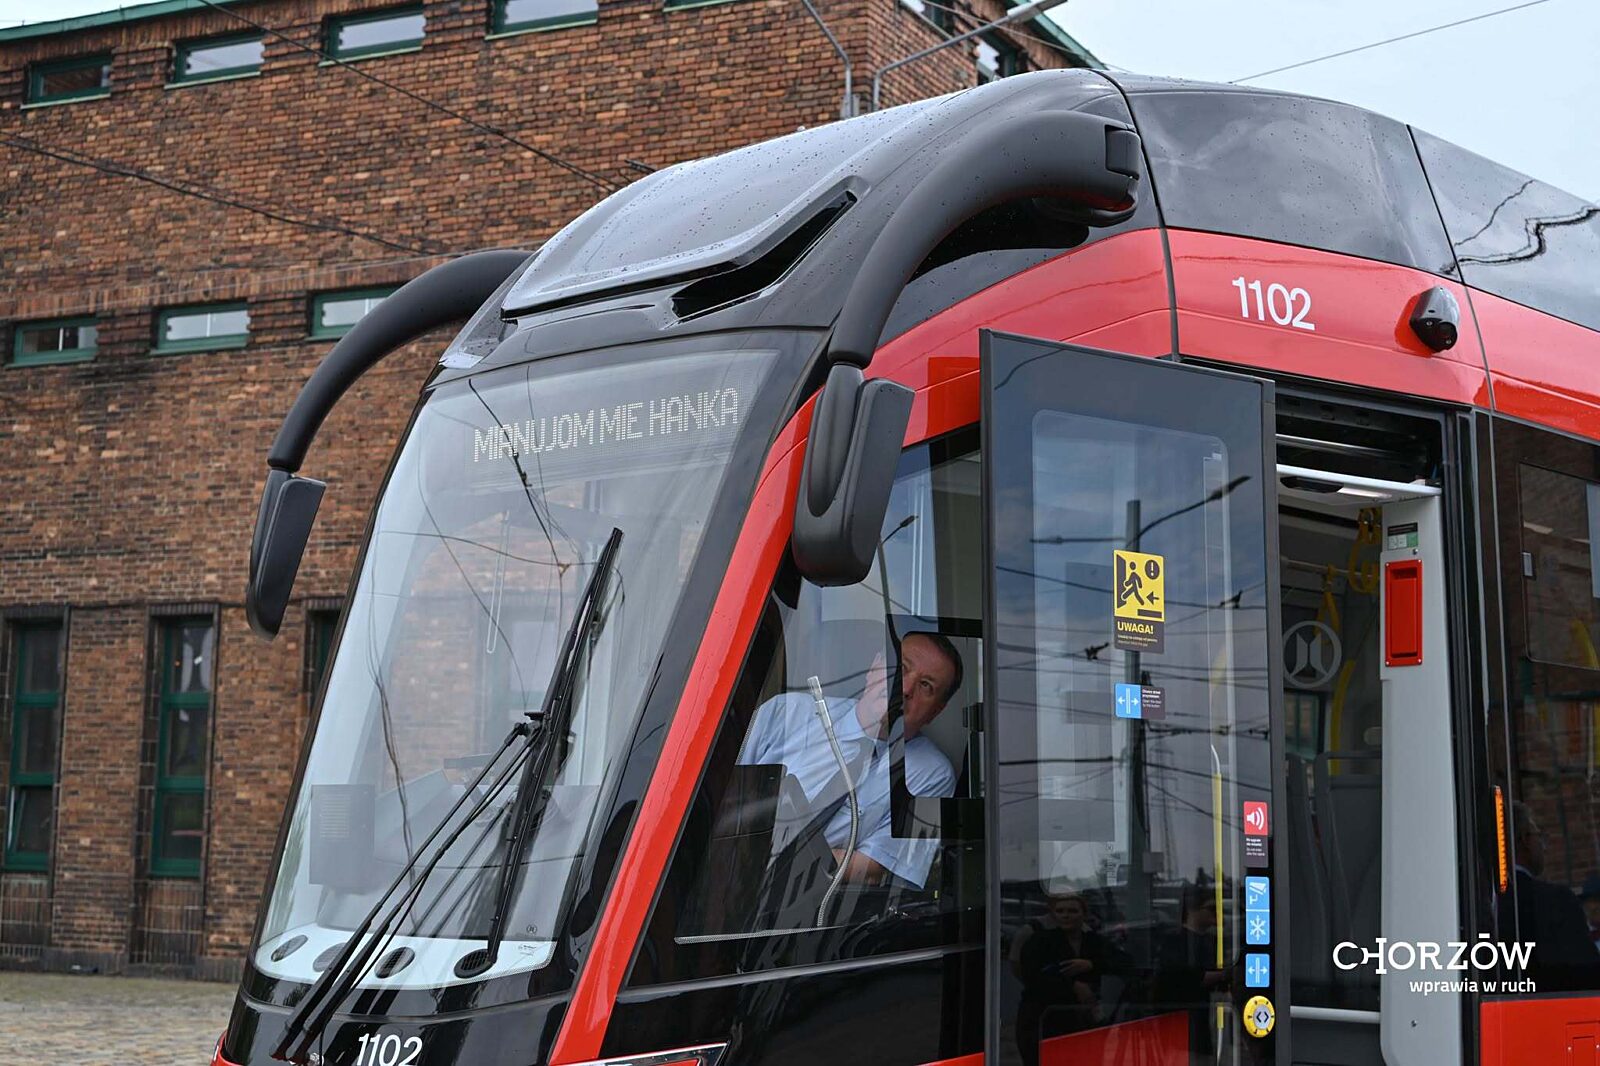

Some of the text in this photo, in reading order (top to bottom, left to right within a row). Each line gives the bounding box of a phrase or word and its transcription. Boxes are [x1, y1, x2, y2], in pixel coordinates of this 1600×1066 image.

[1232, 276, 1315, 331] 1102
[474, 387, 738, 462] MIANUJOM MIE HANKA
[1117, 621, 1154, 635] UWAGA!
[357, 1033, 423, 1066] 1102
